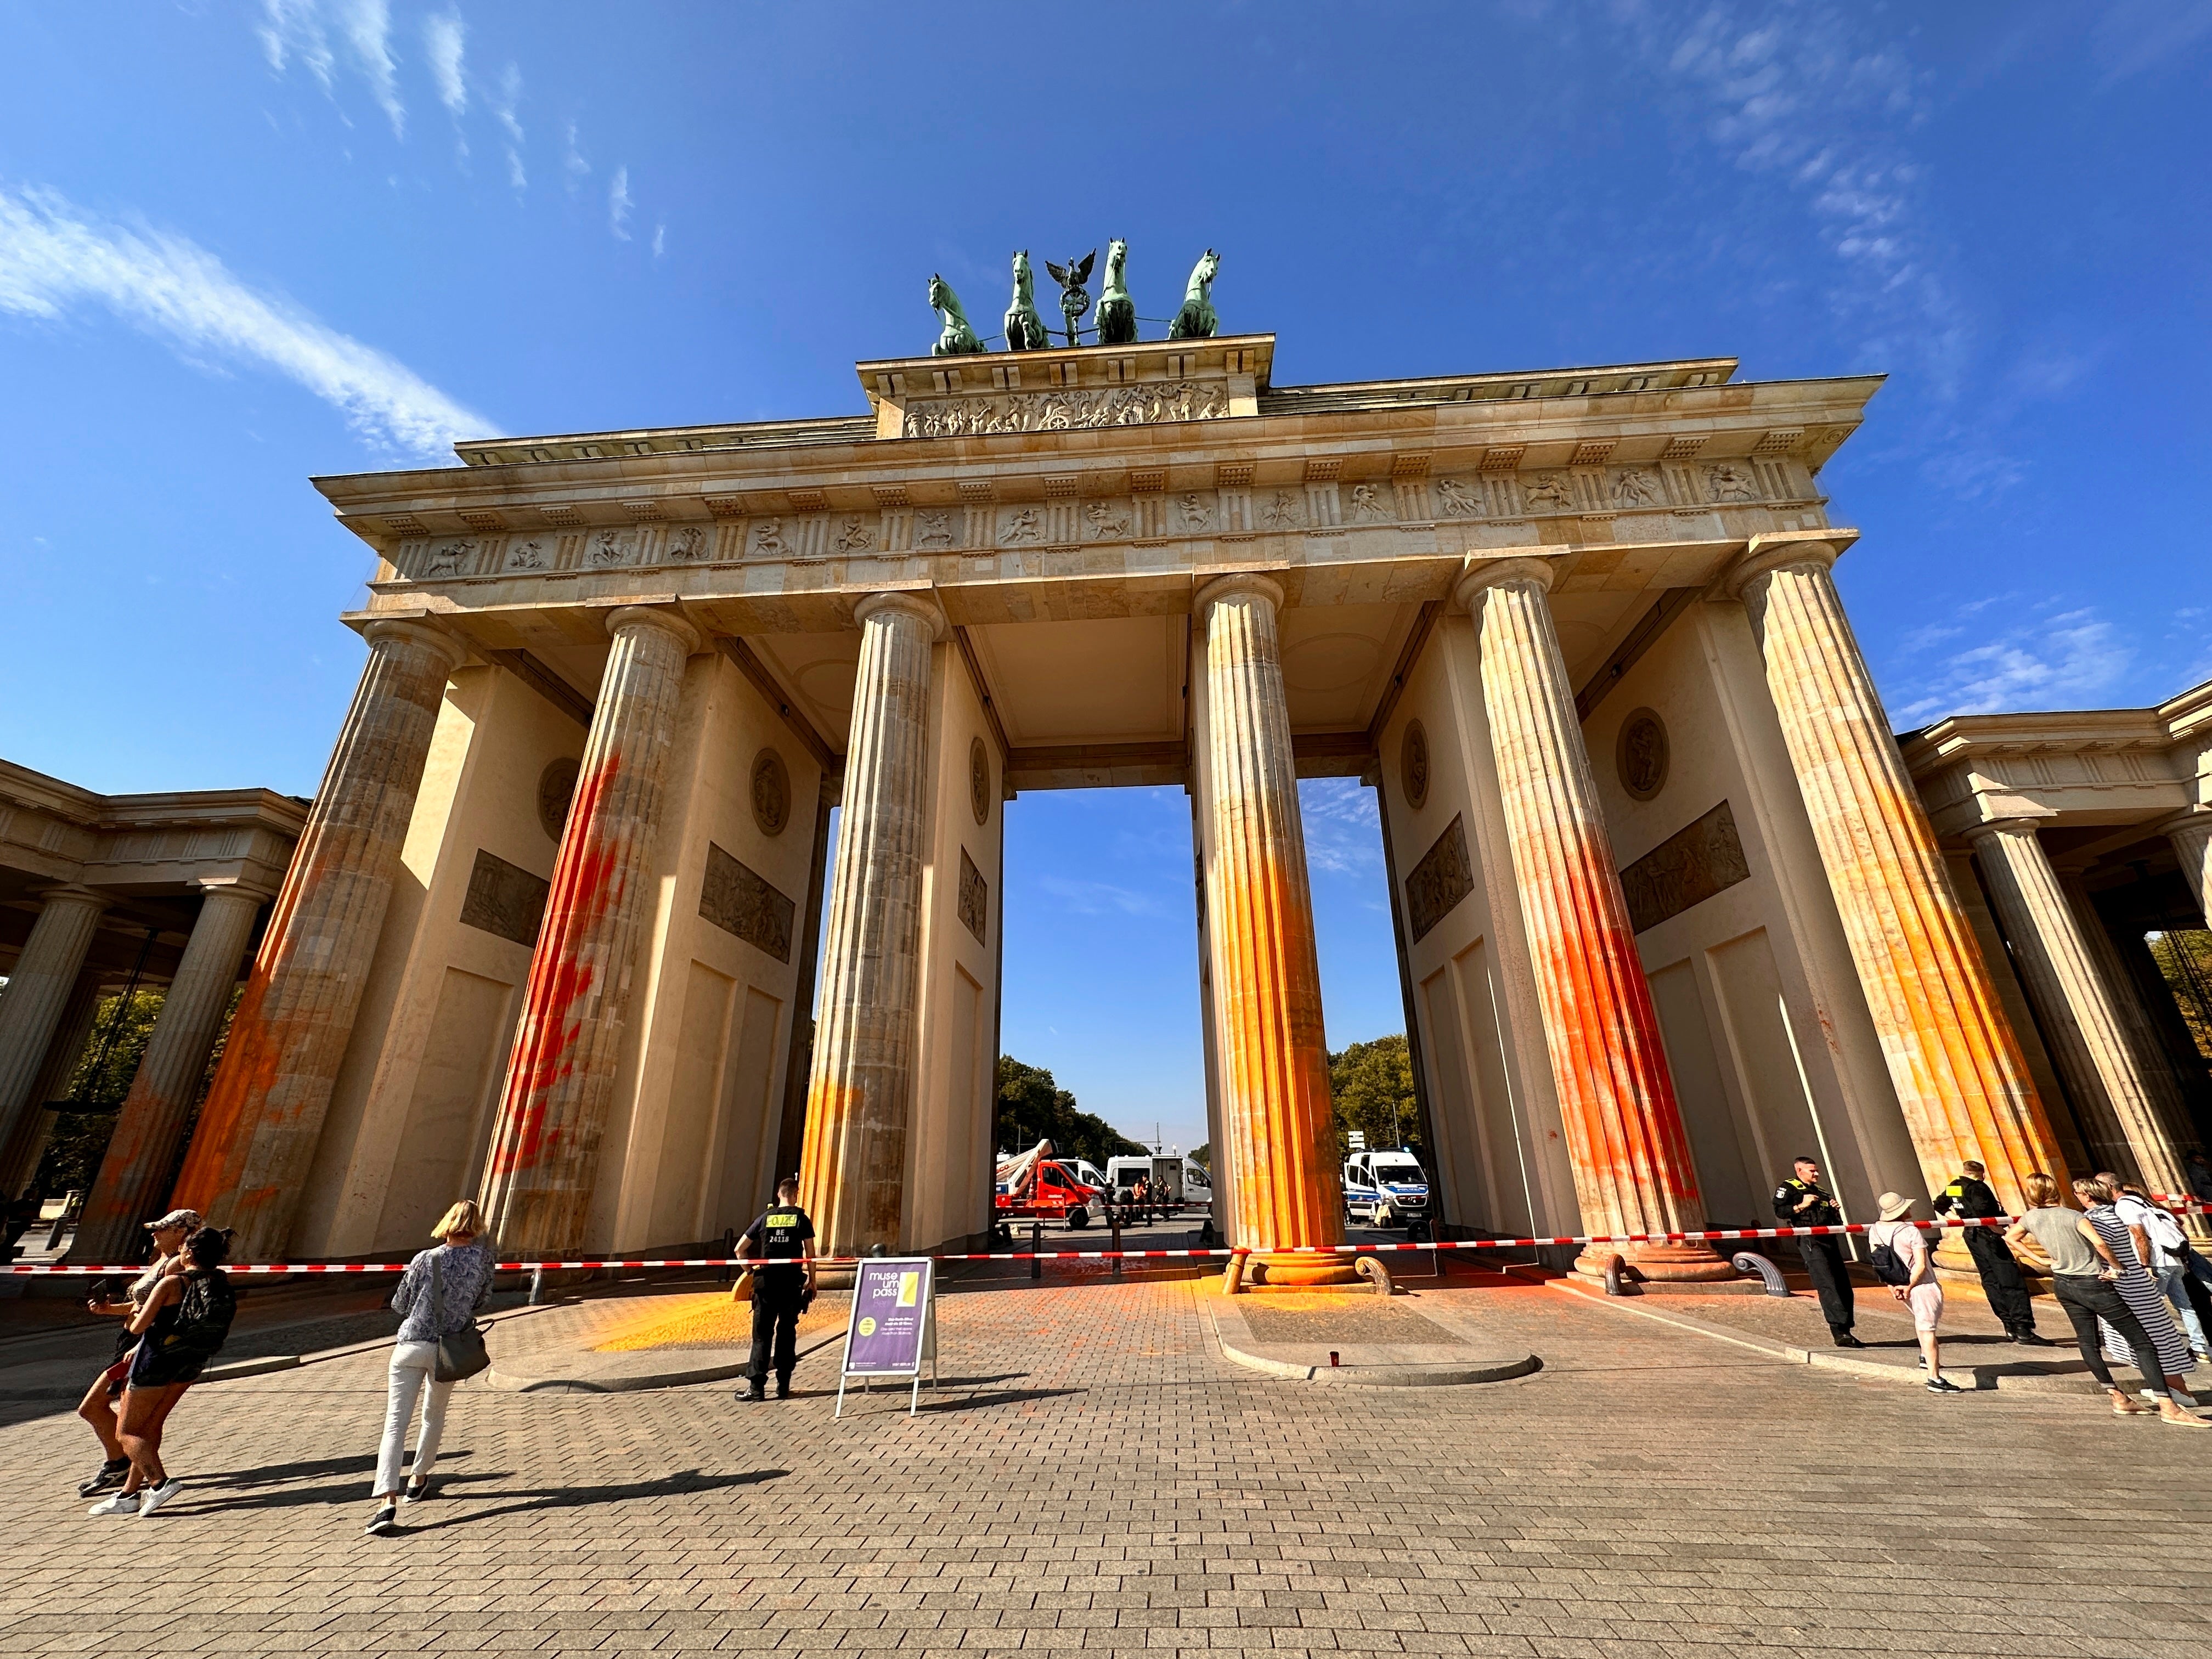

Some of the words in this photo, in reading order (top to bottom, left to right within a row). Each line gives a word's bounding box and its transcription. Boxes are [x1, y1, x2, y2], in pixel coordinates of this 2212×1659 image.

[869, 1272, 898, 1280] muse
[882, 1280, 899, 1288] um
[872, 1288, 898, 1299] pass
